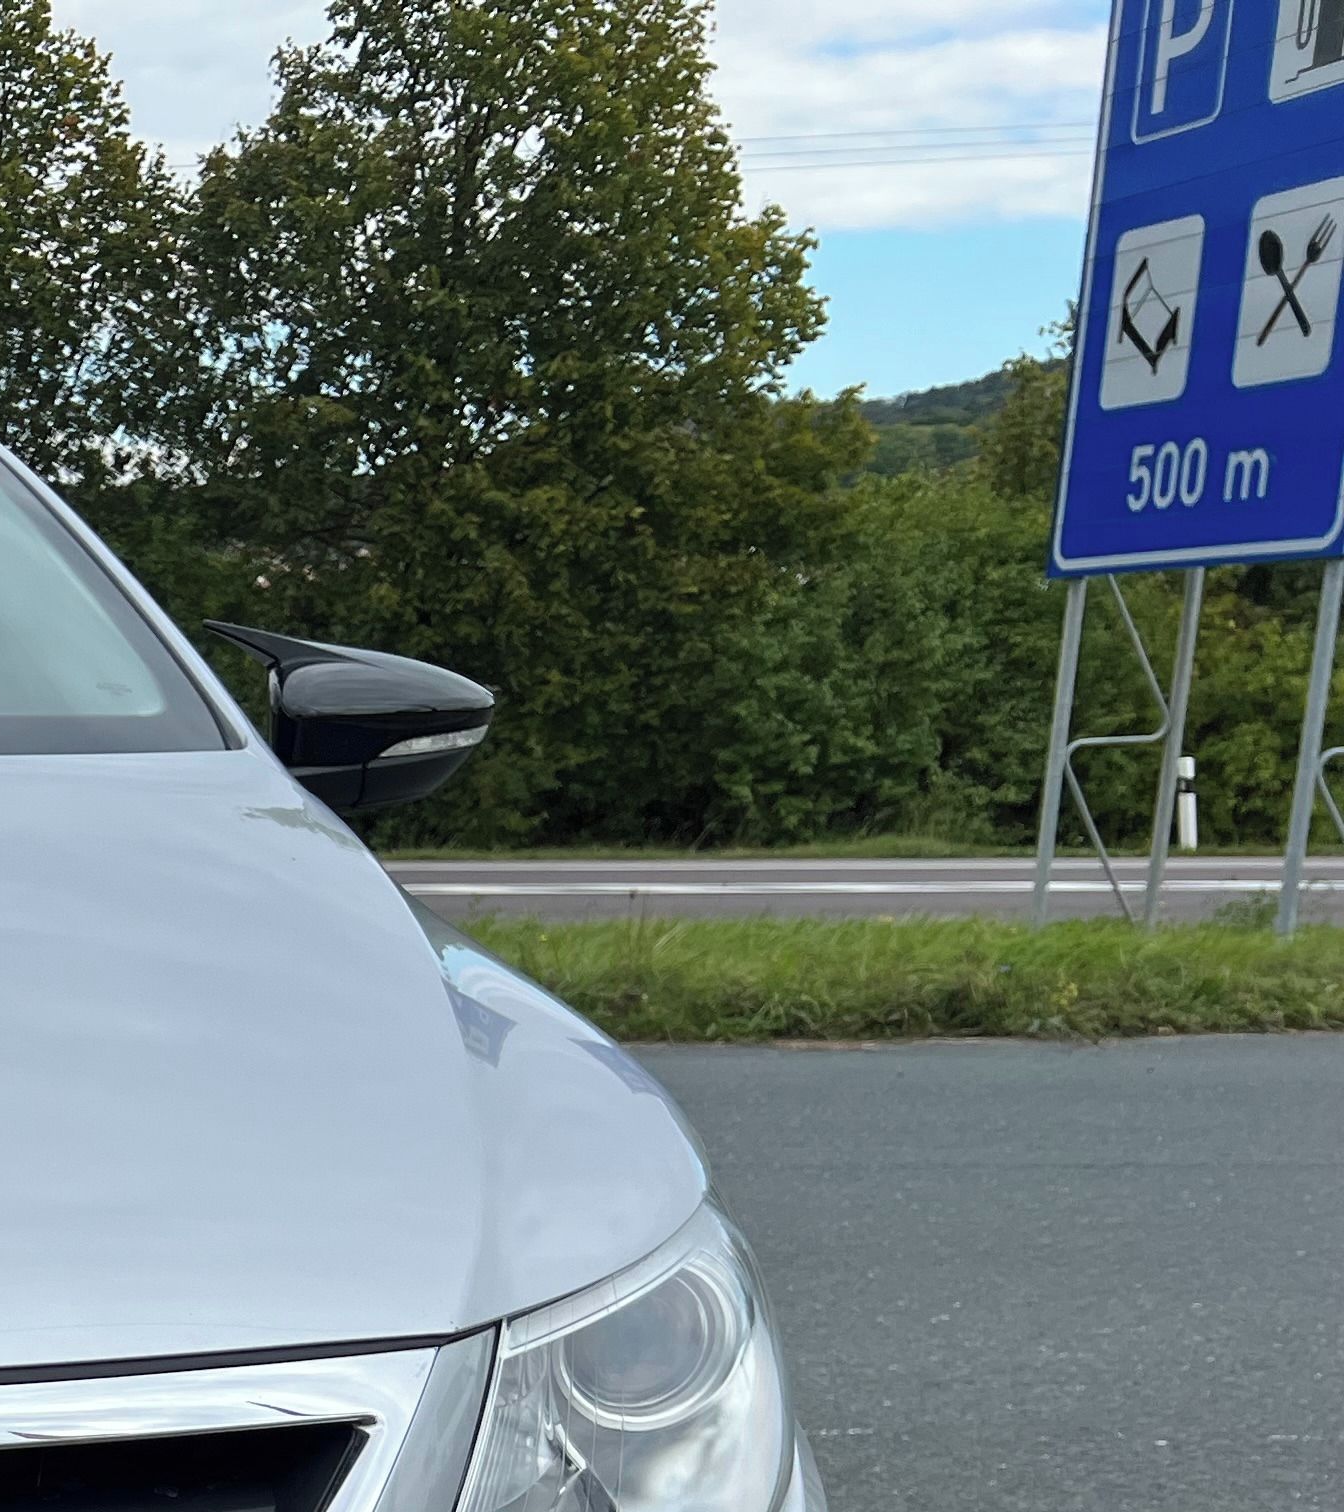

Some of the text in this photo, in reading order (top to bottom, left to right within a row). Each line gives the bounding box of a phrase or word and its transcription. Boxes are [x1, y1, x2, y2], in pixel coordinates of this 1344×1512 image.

[1150, 0, 1214, 115] P
[1127, 438, 1269, 511] 500 m
